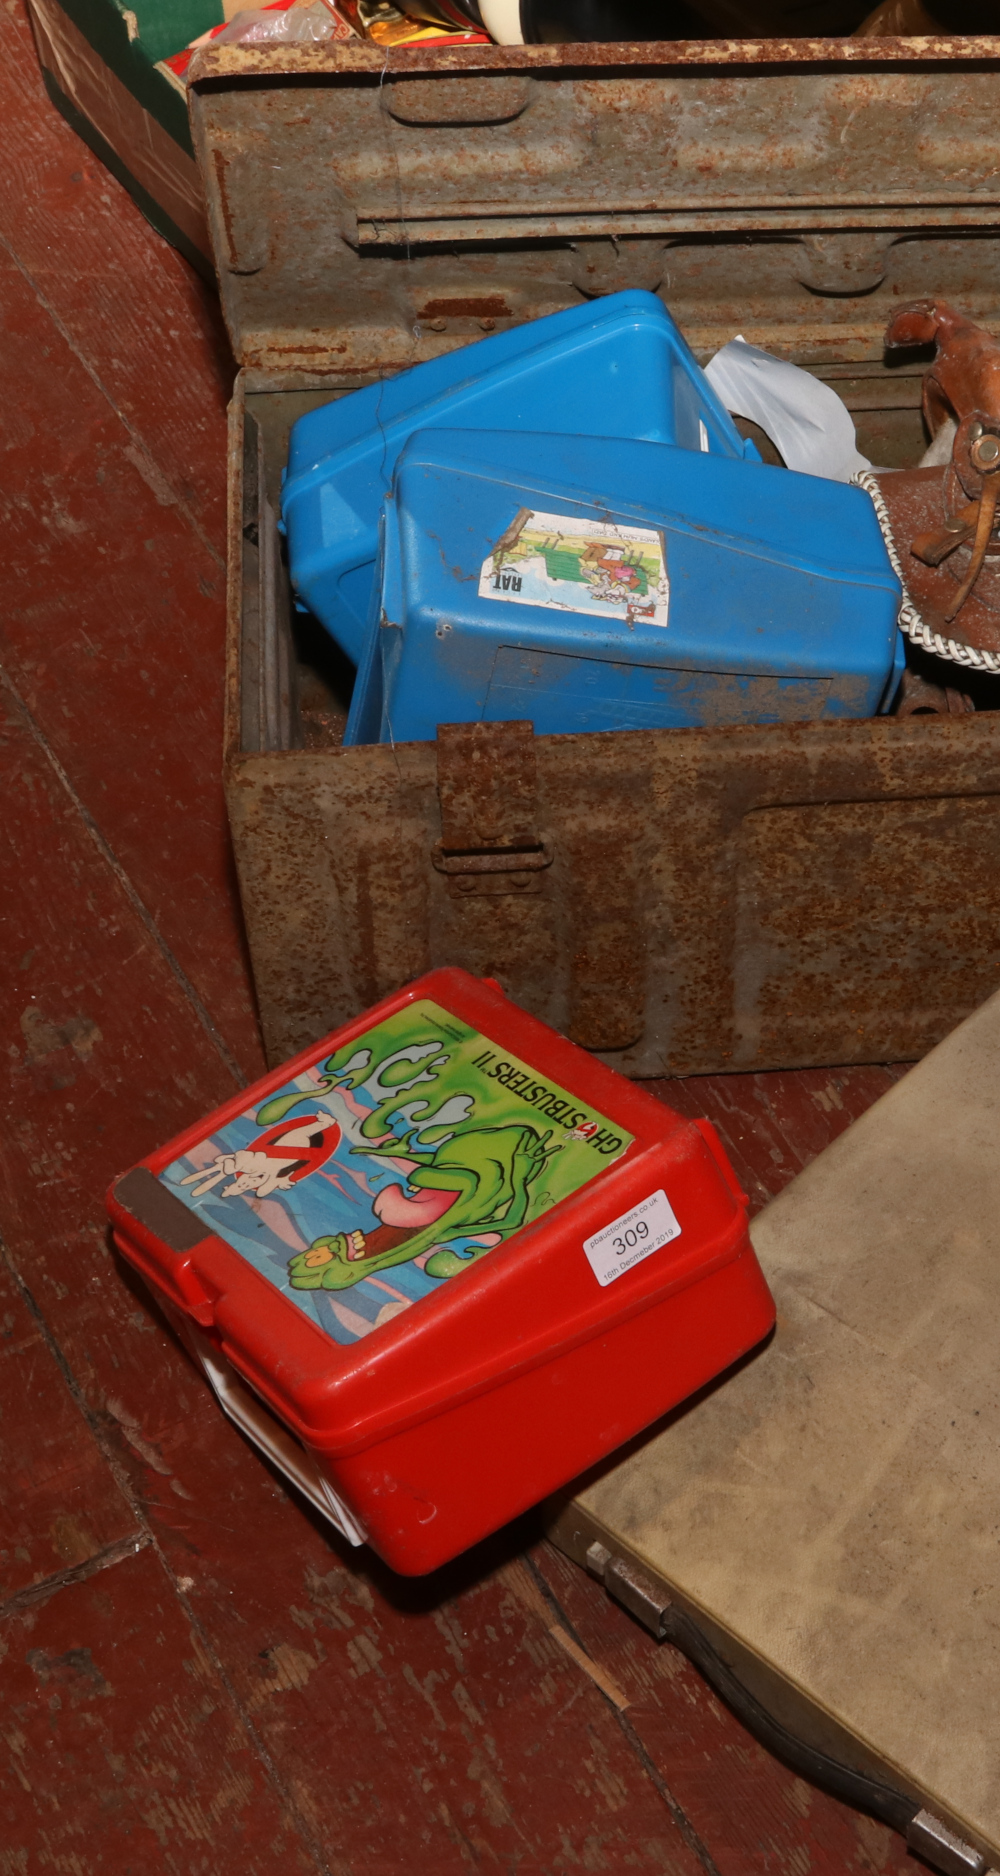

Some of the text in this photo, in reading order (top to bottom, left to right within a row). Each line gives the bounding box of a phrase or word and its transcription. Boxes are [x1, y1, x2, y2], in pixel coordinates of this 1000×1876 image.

[493, 575, 522, 592] RAT
[487, 1061, 623, 1155] GHOSTBUSTERS
[590, 1197, 658, 1249] pbauctioneers.co.uk
[612, 1221, 649, 1256] 309
[603, 1228, 674, 1281] 16th Decmeber 2019
